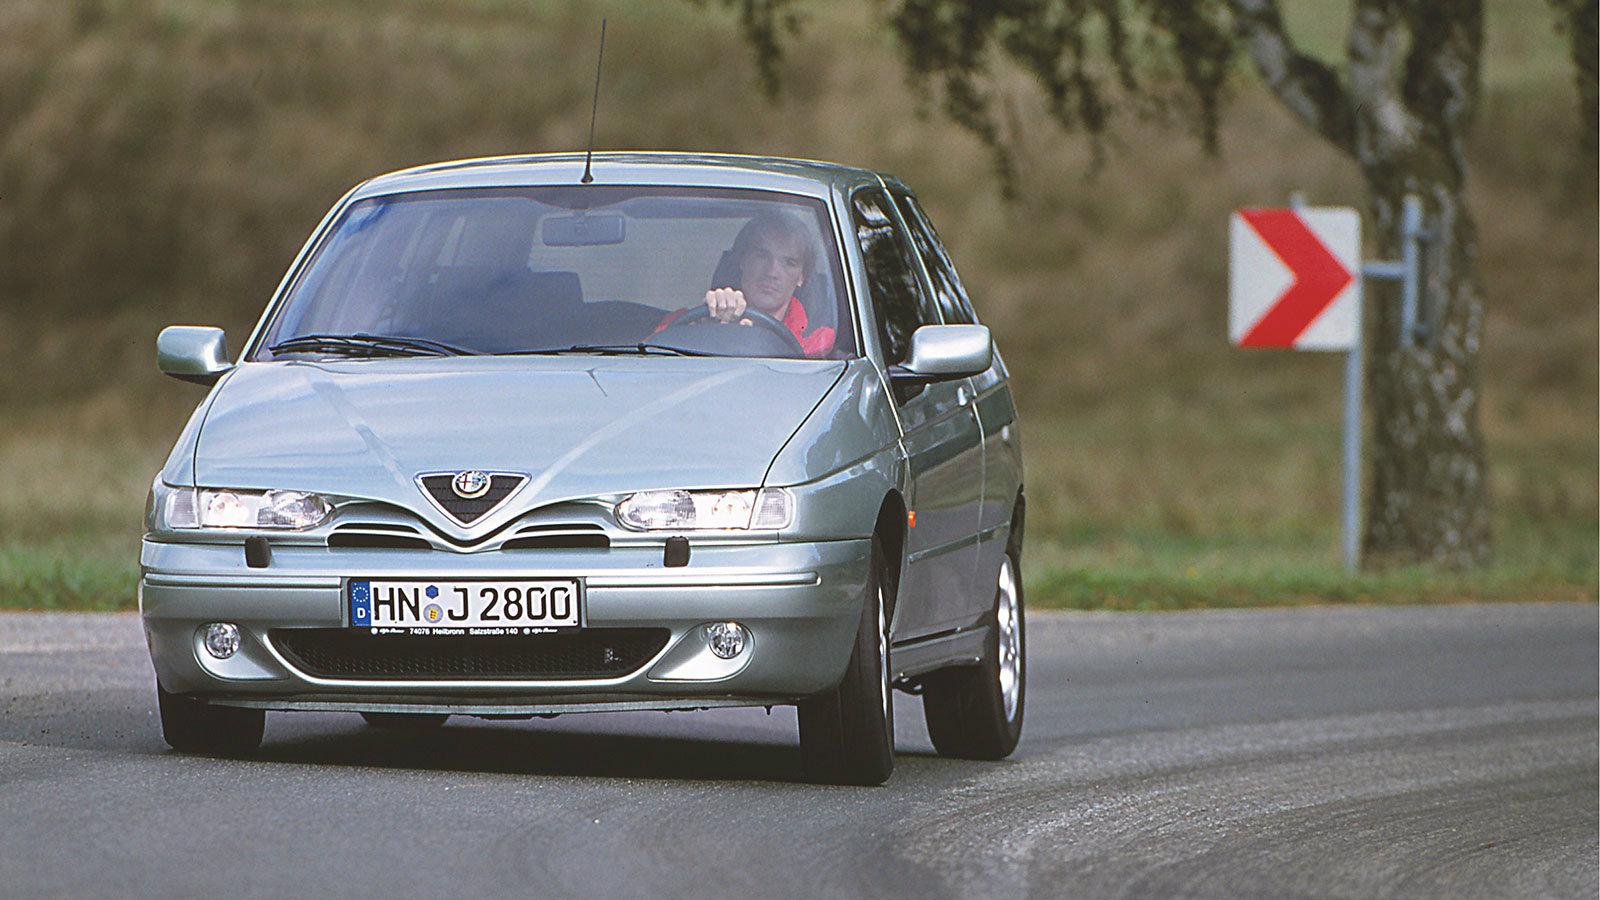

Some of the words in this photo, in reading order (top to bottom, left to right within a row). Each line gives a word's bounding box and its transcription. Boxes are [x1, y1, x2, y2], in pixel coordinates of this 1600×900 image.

[357, 607, 366, 619] D
[373, 587, 420, 621] HN
[447, 587, 469, 621] J
[479, 587, 571, 621] 2800
